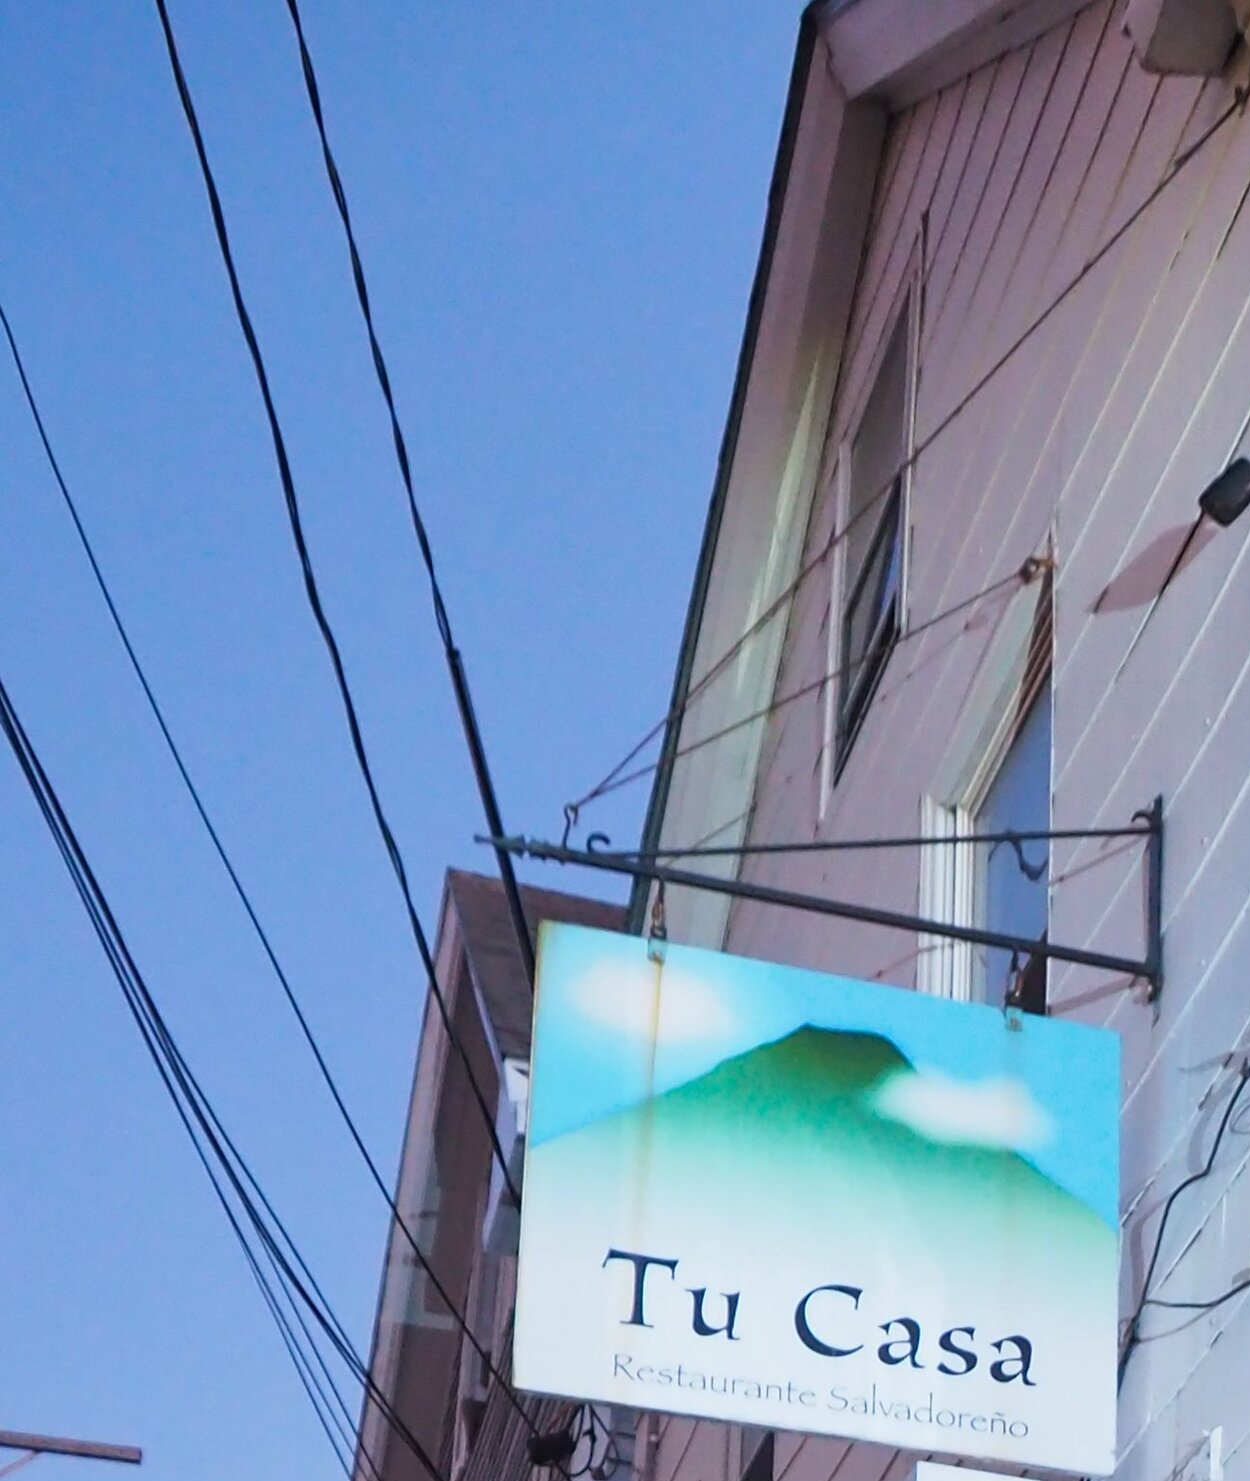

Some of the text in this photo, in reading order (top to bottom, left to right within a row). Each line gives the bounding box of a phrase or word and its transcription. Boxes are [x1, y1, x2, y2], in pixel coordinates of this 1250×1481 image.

[602, 1248, 1037, 1387] Tu Casa
[612, 1353, 1030, 1438] Restaurante Salvadoreño
